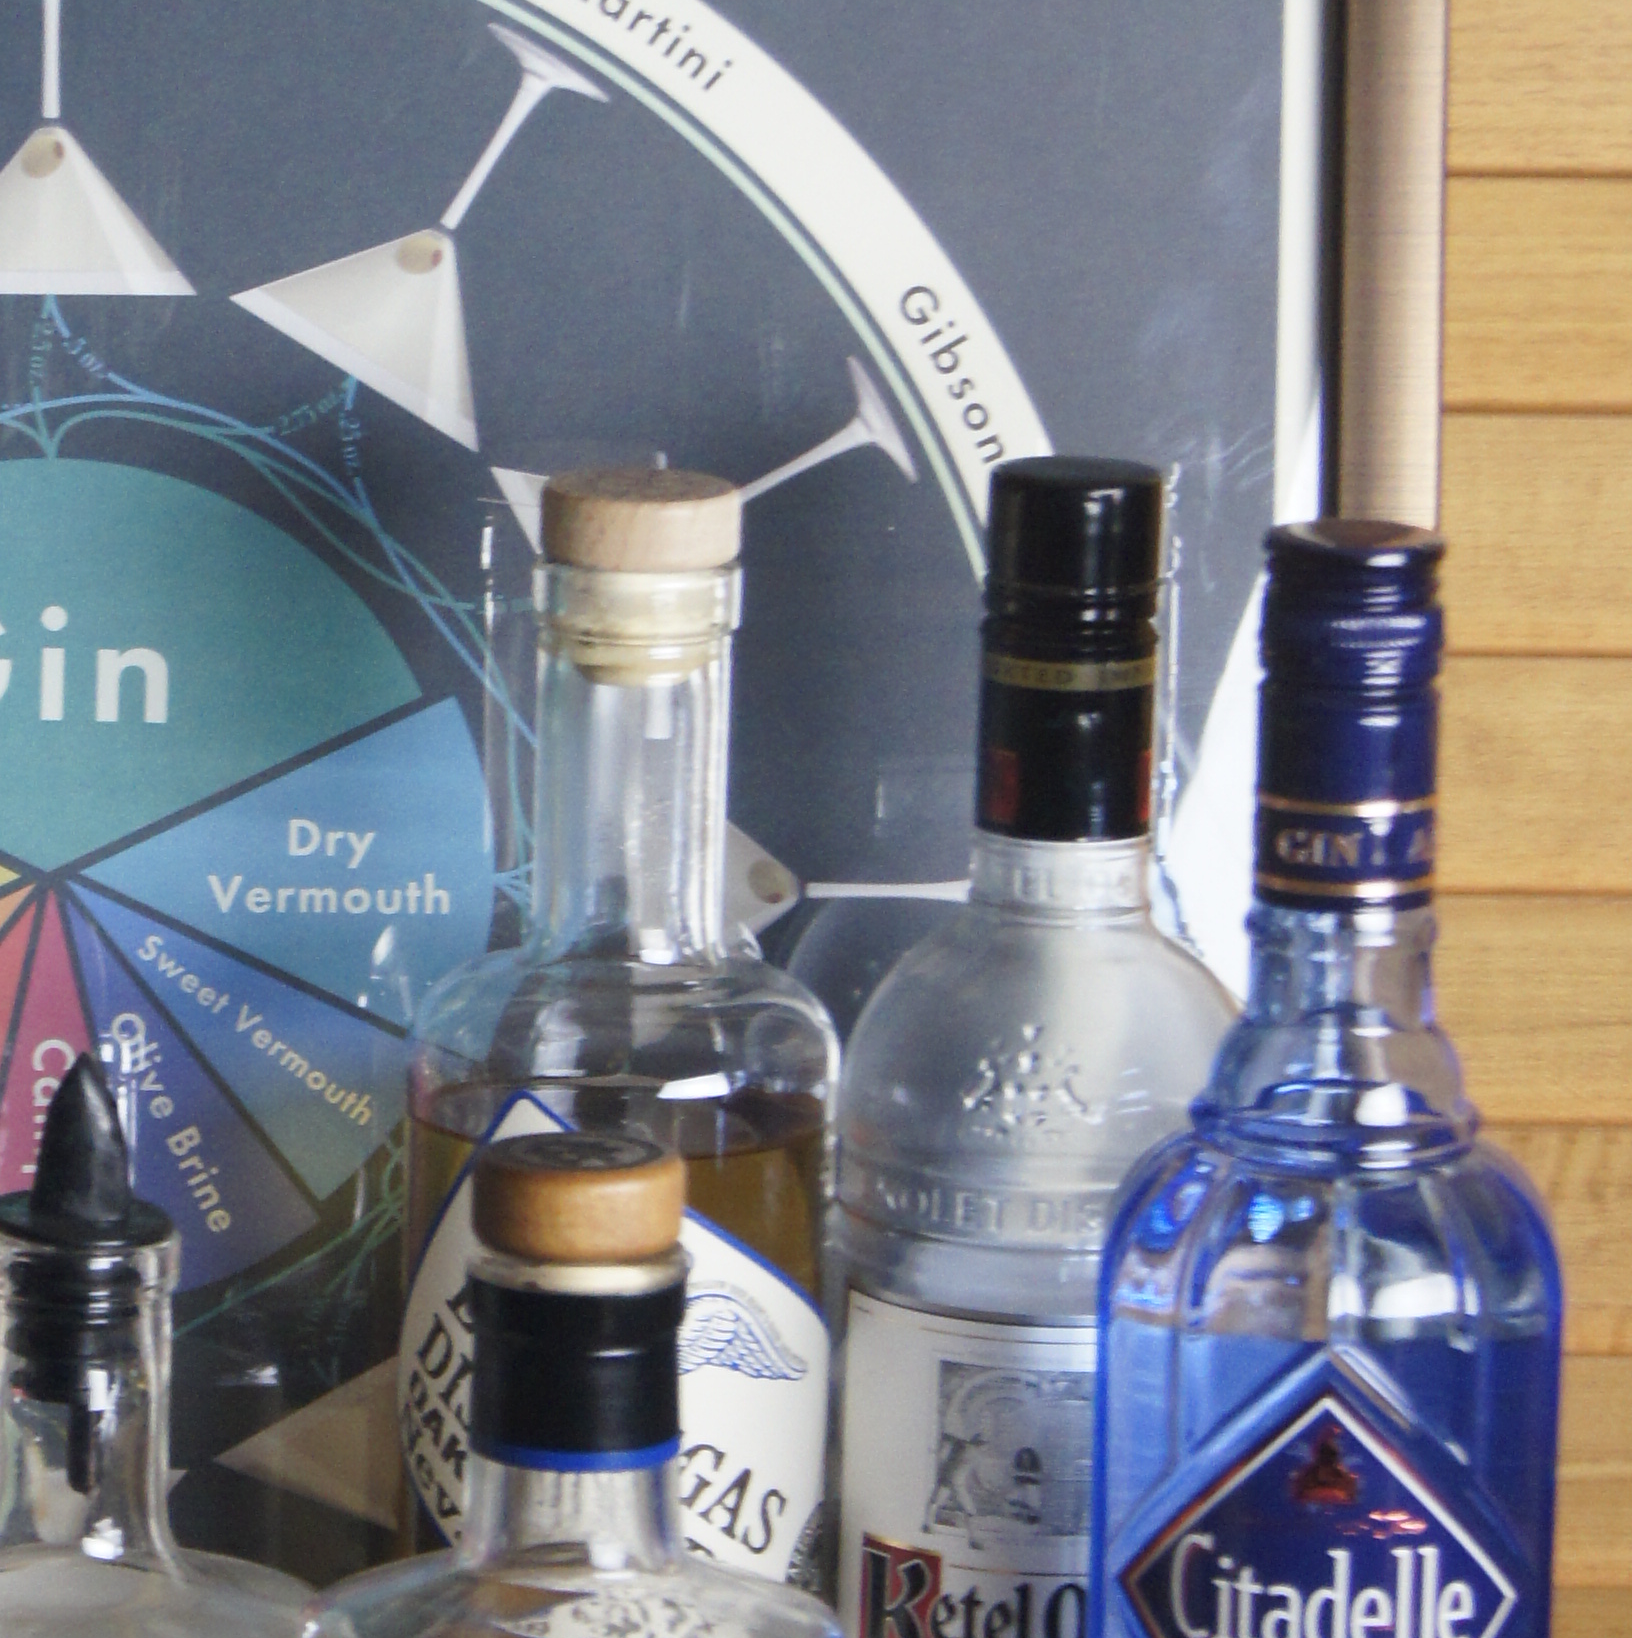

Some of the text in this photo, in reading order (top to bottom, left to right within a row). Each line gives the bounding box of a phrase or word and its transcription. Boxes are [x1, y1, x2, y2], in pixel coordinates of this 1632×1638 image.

[899, 285, 1007, 465] Gibson
[207, 872, 451, 916] Vermouth
[288, 819, 376, 869] Dry
[136, 935, 374, 1126] Sweet Vermouth
[166, 1124, 232, 1234] Brine
